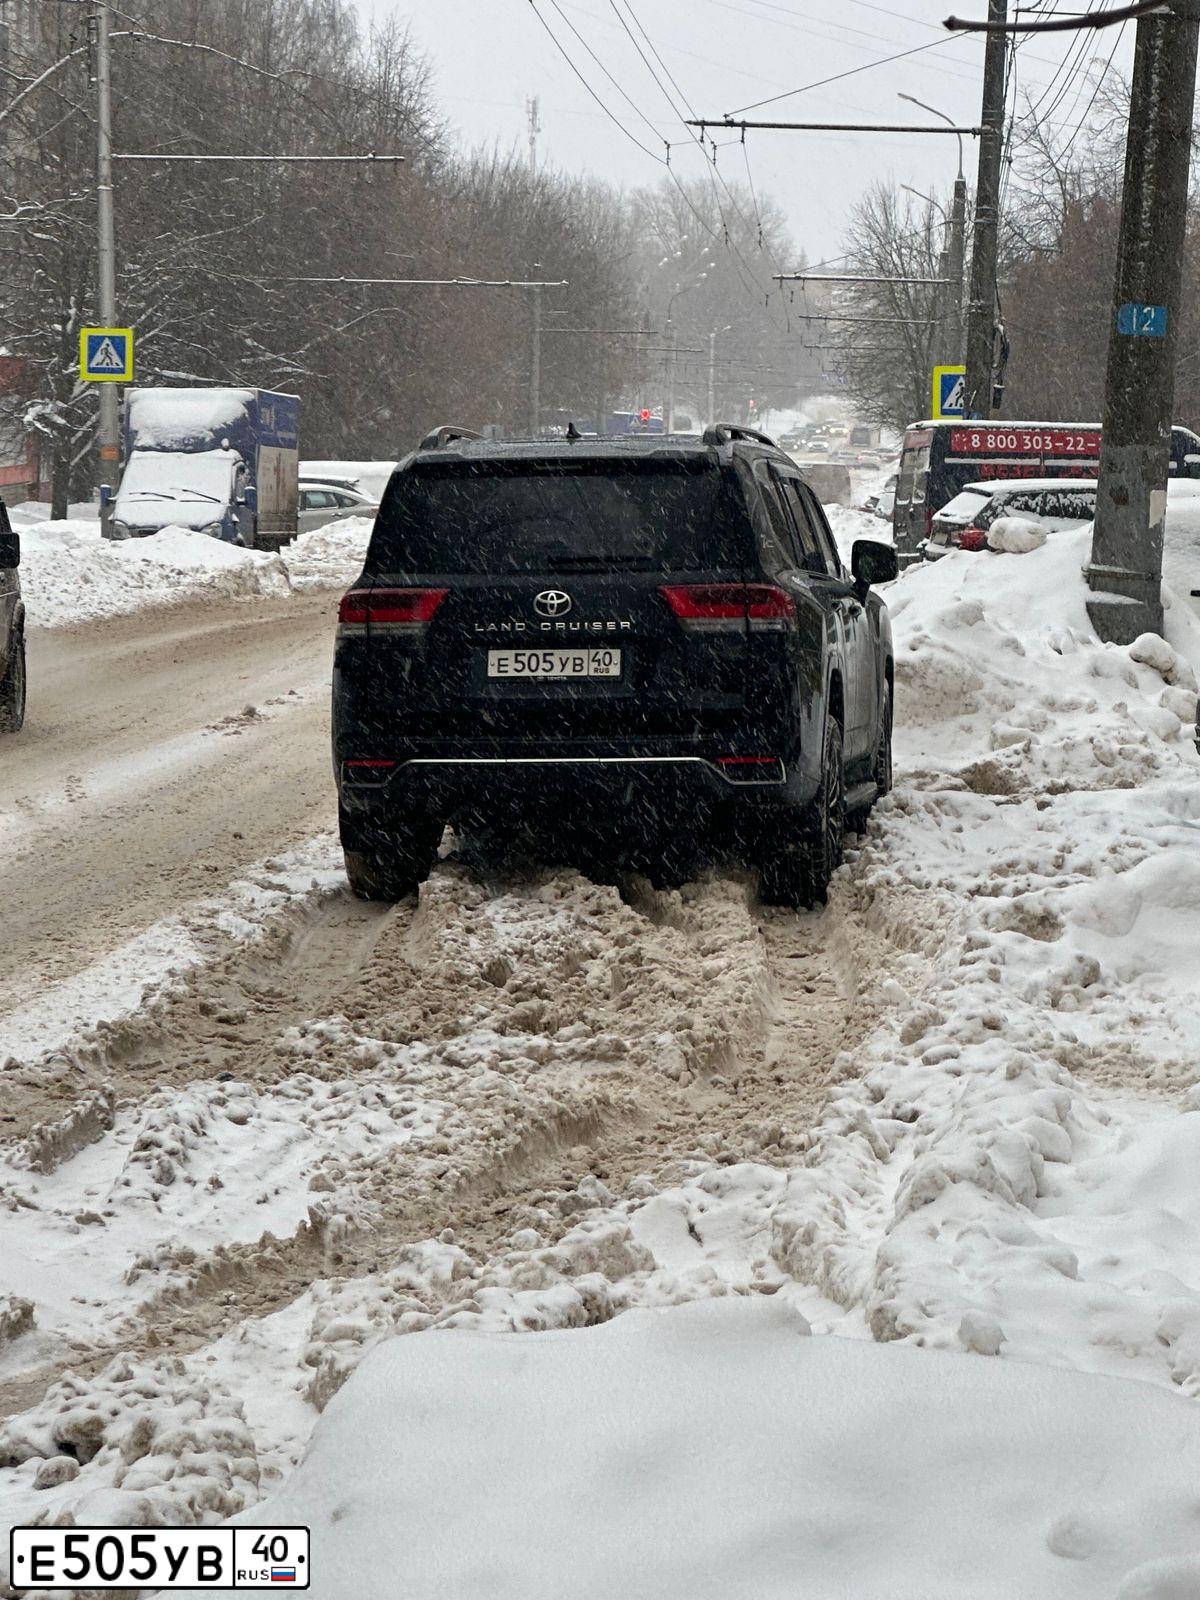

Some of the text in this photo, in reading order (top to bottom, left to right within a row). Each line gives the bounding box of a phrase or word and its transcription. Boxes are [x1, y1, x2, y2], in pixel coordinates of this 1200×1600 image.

[1132, 306, 1155, 331] 12
[971, 433, 1101, 451] 8 800 303-22-
[474, 621, 631, 632] LAND CRUISER
[591, 651, 613, 667] 40
